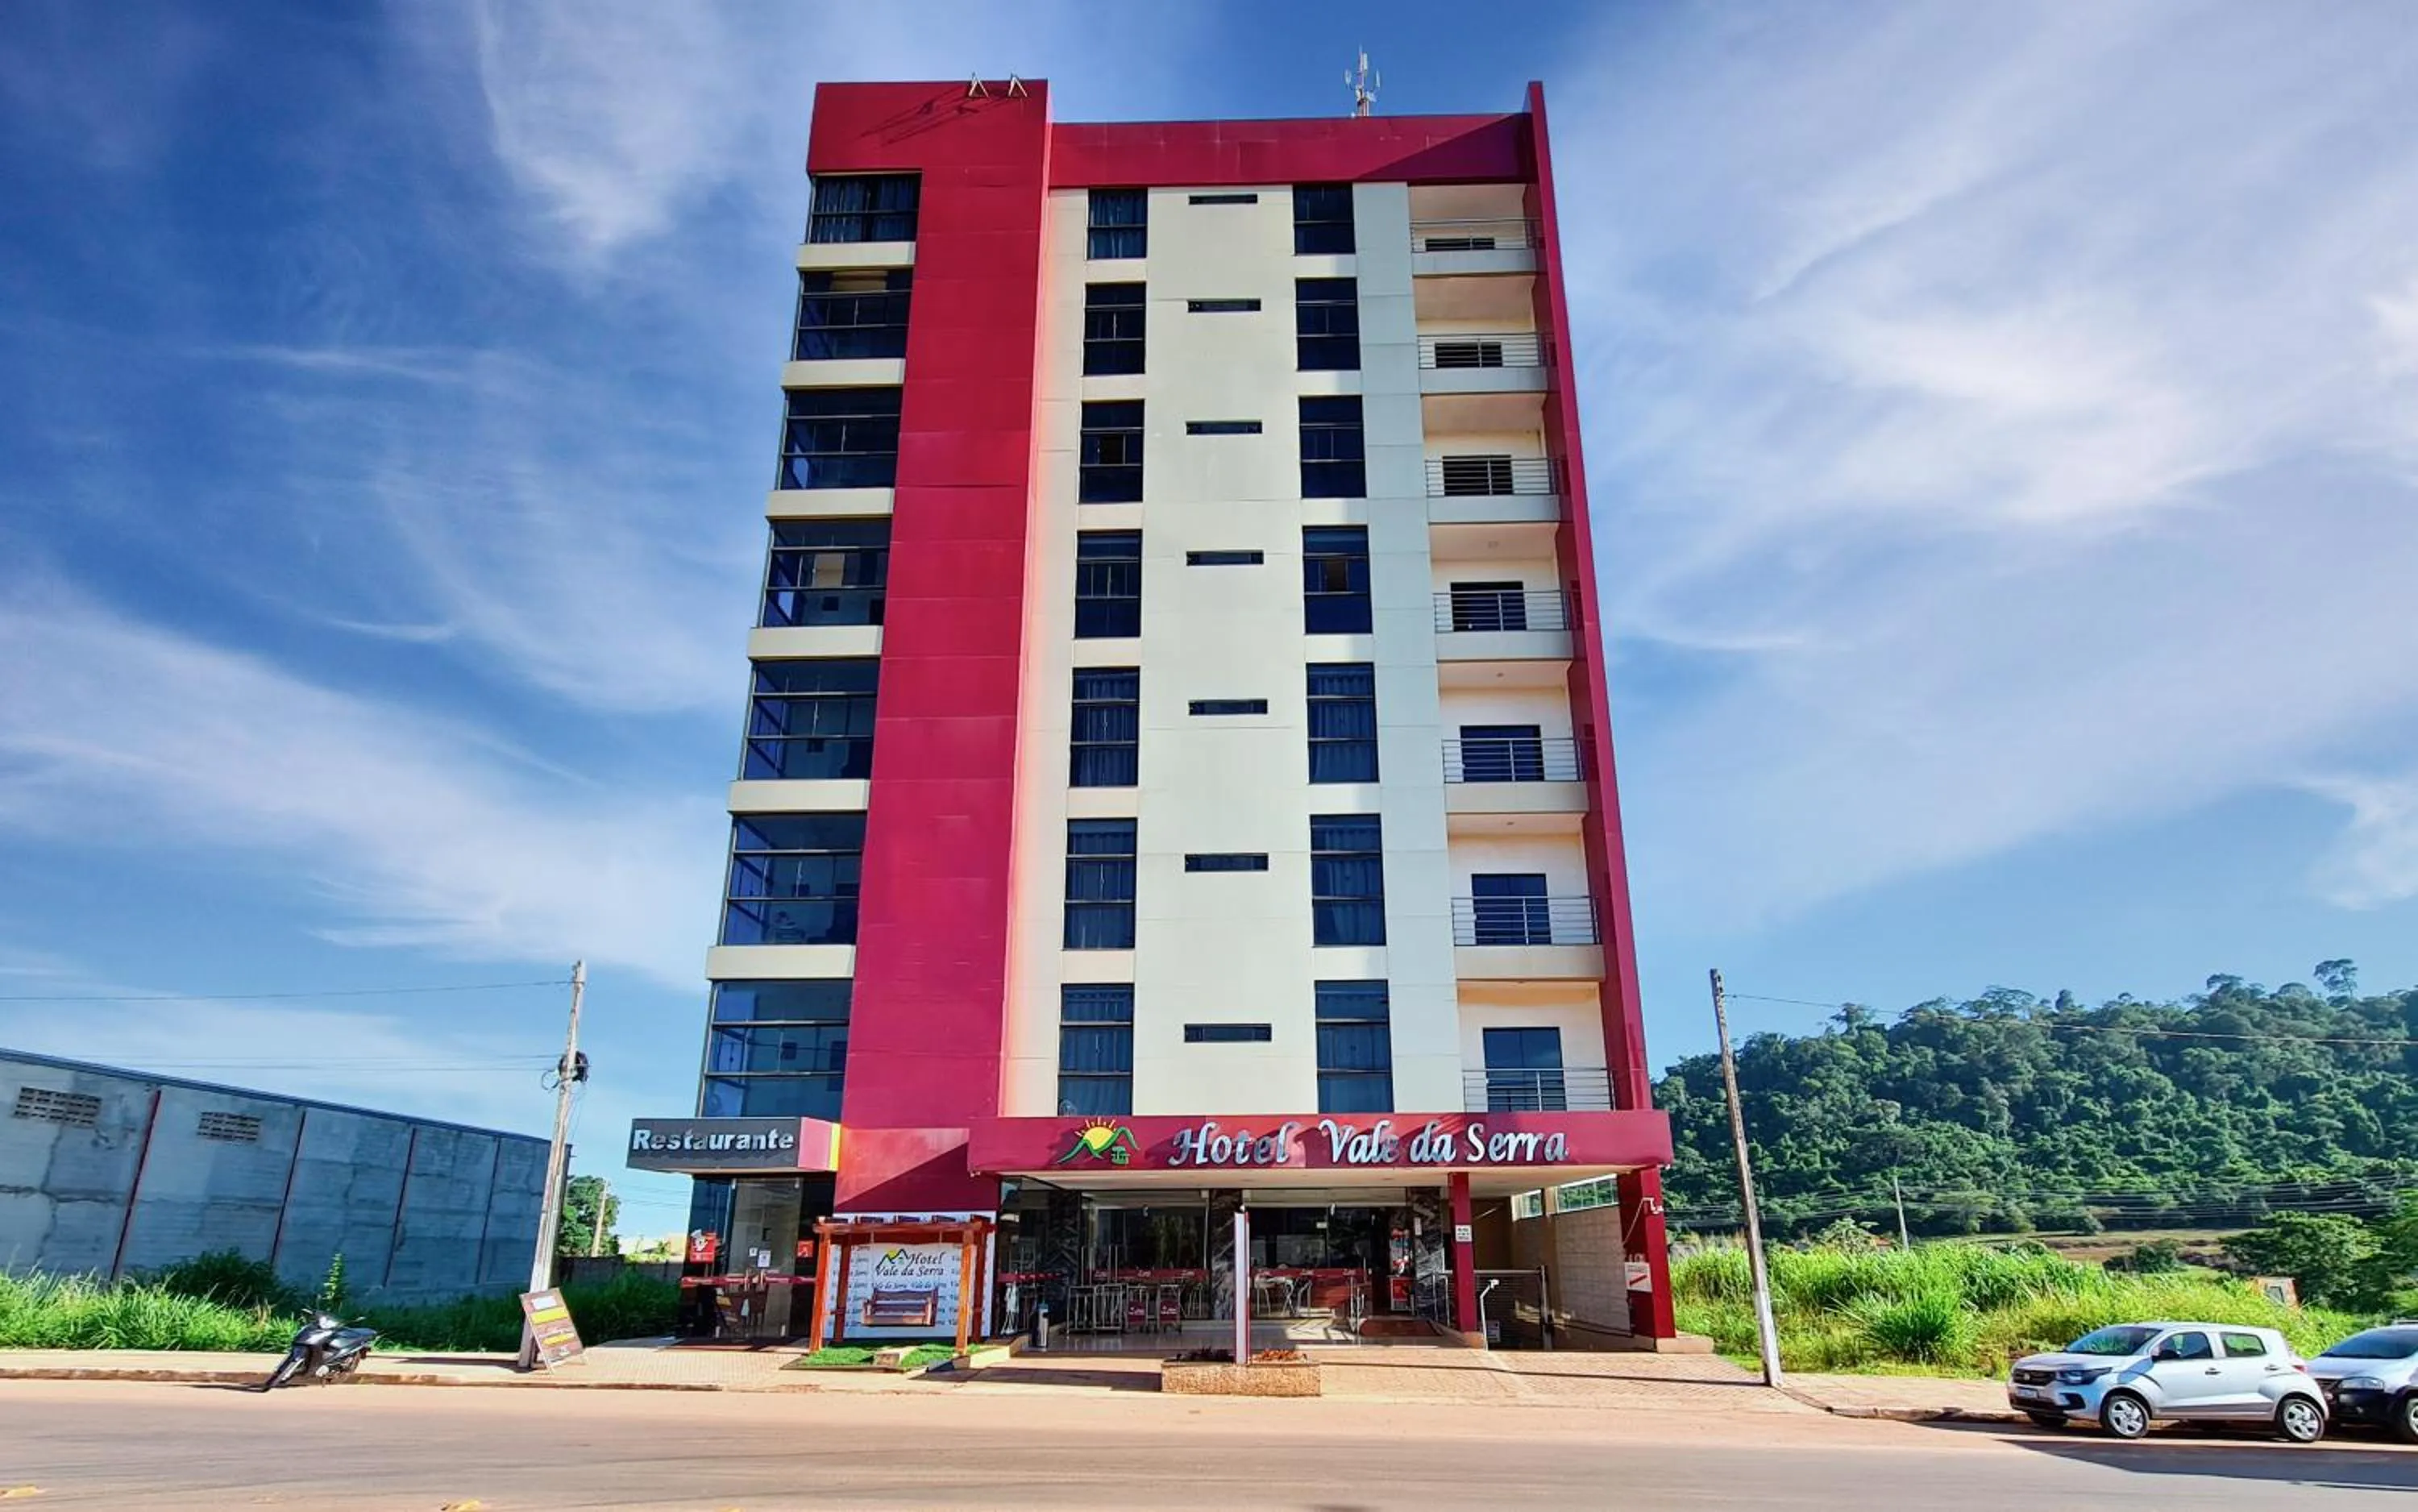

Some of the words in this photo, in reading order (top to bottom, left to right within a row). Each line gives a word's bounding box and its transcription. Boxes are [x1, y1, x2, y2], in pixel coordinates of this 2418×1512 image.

[632, 1128, 795, 1151] Restaurante
[1168, 1121, 1303, 1165] Hotel
[1317, 1119, 1400, 1163] Vale
[1409, 1119, 1456, 1163] da
[1465, 1123, 1569, 1162] Serra
[906, 1251, 946, 1267] Hotel
[875, 1265, 898, 1276] Vale
[900, 1265, 914, 1276] da
[916, 1265, 944, 1277] Serra
